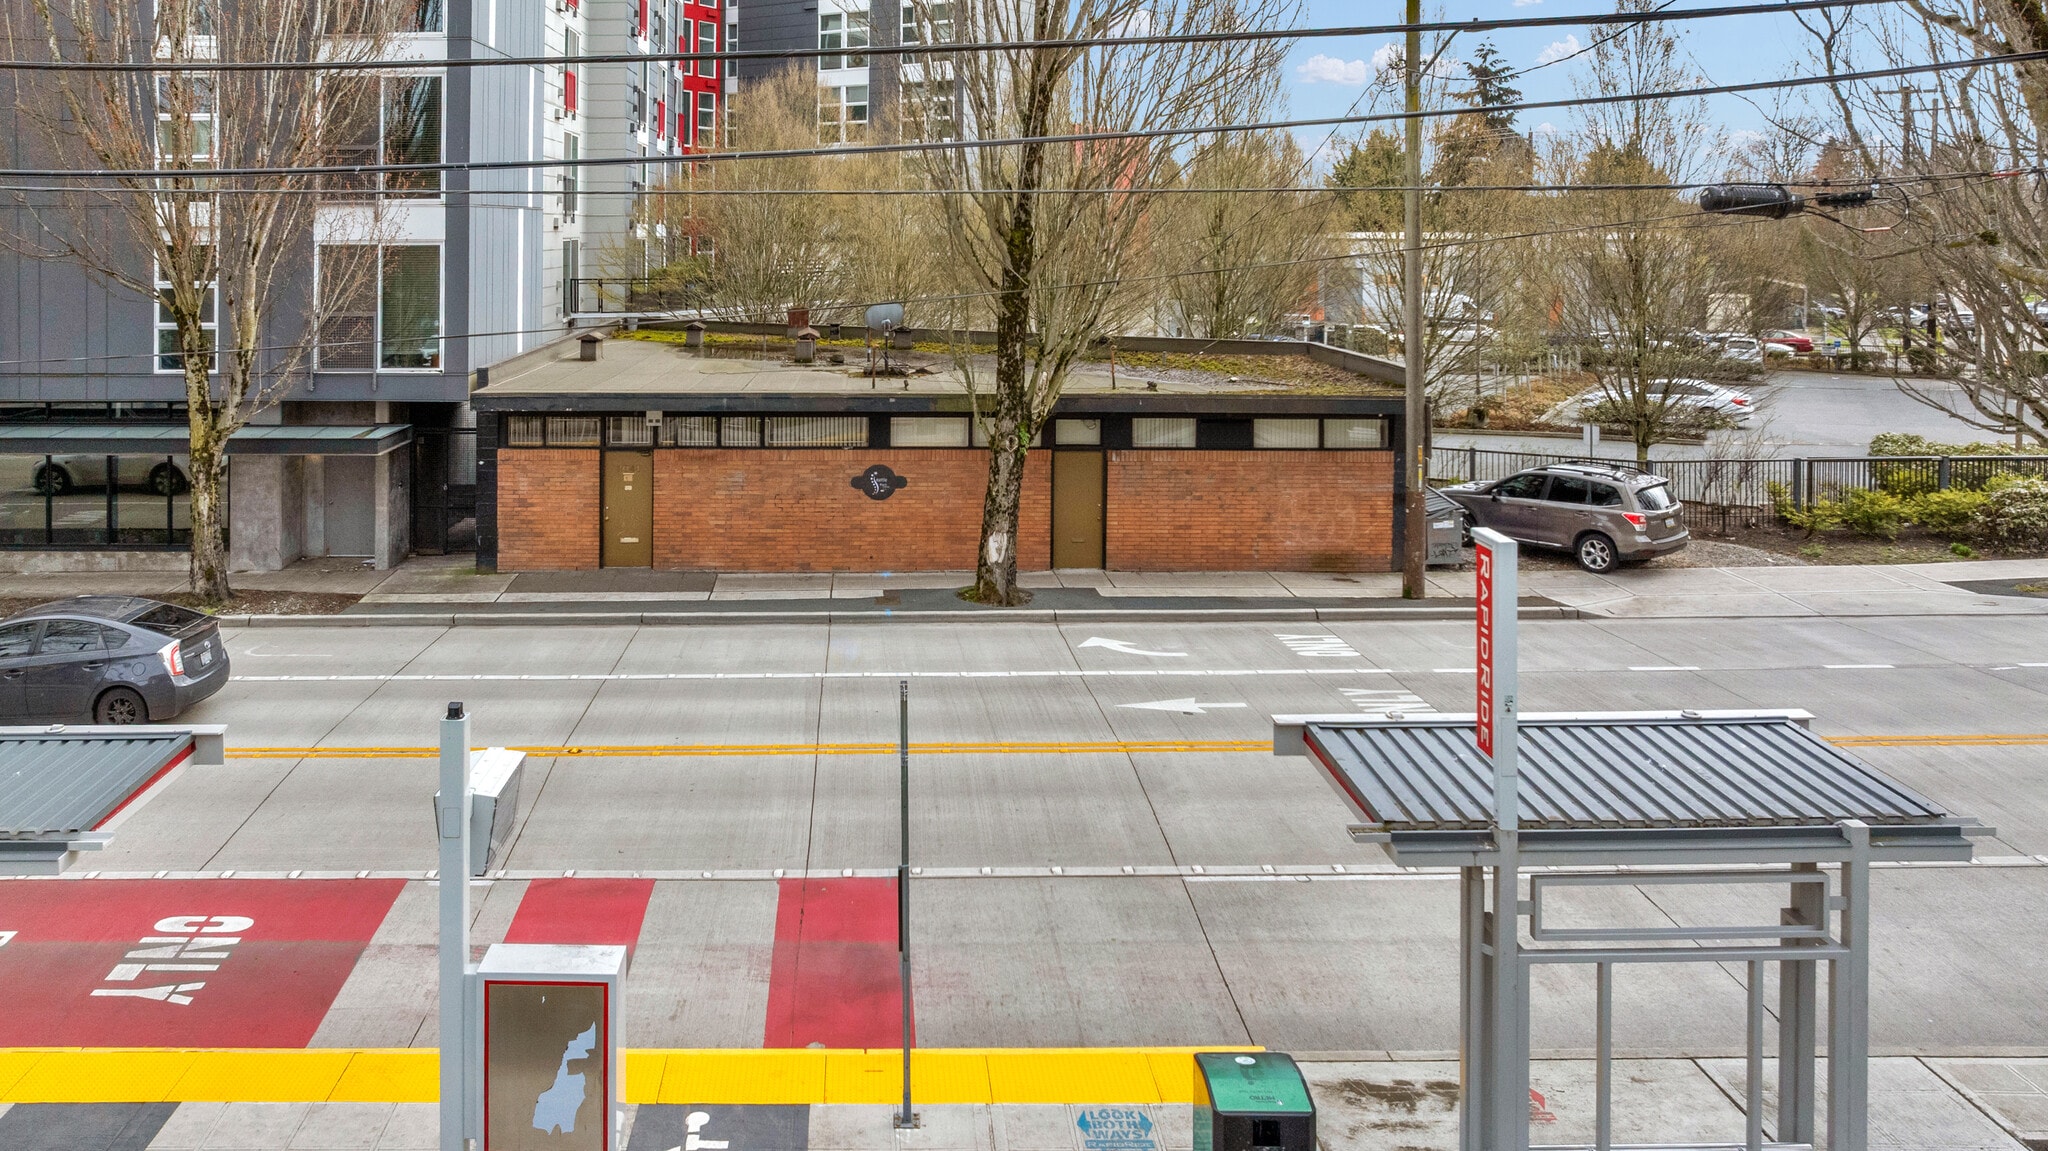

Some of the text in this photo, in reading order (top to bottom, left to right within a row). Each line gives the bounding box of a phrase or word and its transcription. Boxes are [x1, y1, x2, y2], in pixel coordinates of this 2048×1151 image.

[1274, 634, 1361, 656] ONLY
[1337, 687, 1441, 713] NLY
[89, 915, 255, 1006] ONLY
[1089, 1108, 1136, 1120] LOOK
[1090, 1120, 1139, 1129] BOTH
[1092, 1129, 1143, 1139] WAYS
